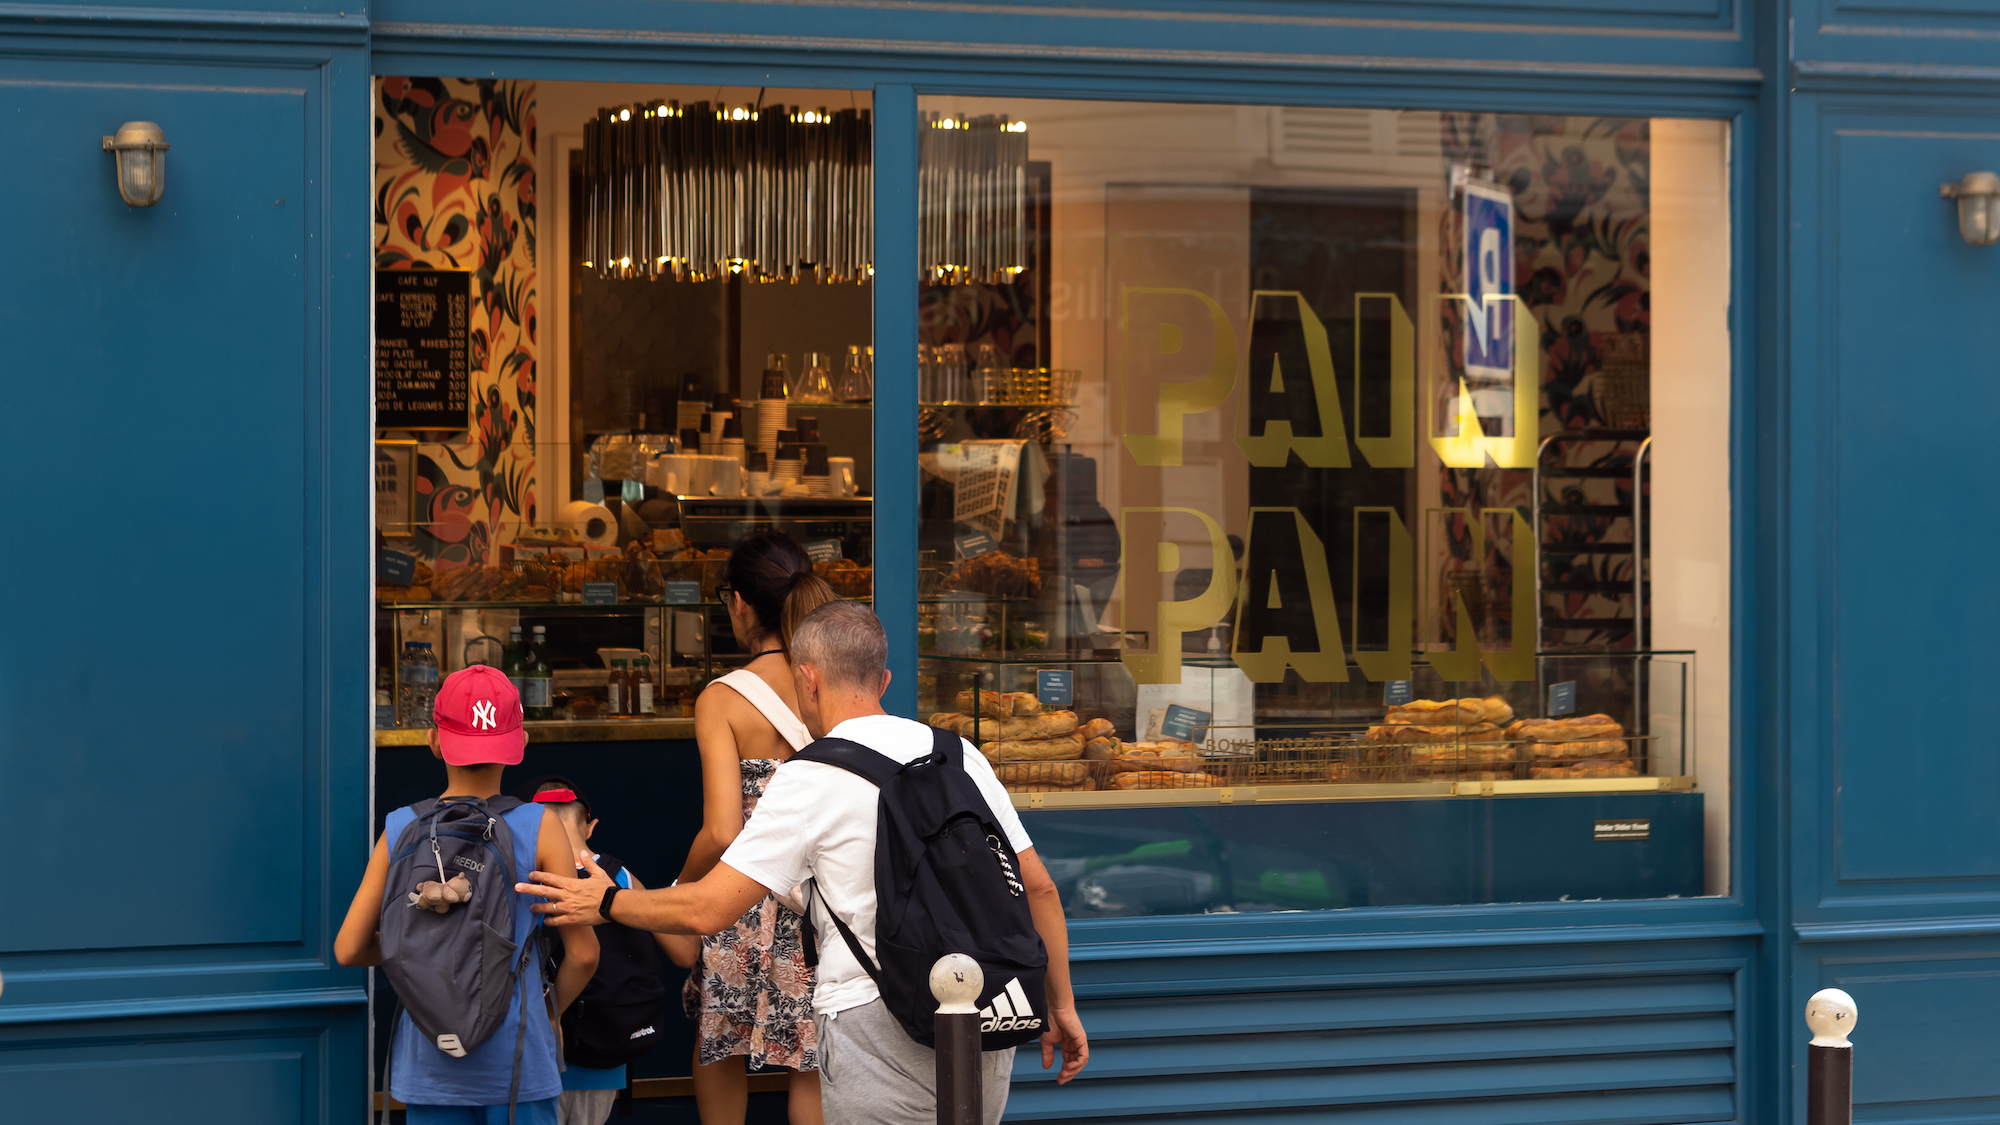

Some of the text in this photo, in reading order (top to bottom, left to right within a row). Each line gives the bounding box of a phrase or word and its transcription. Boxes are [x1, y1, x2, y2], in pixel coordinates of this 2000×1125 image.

[423, 277, 438, 287] ILLY
[392, 350, 415, 359] PLATE
[1122, 287, 1539, 468] PAIN
[393, 401, 403, 411] DE
[1120, 506, 1536, 684] PAIN
[980, 1016, 1042, 1033] didas
